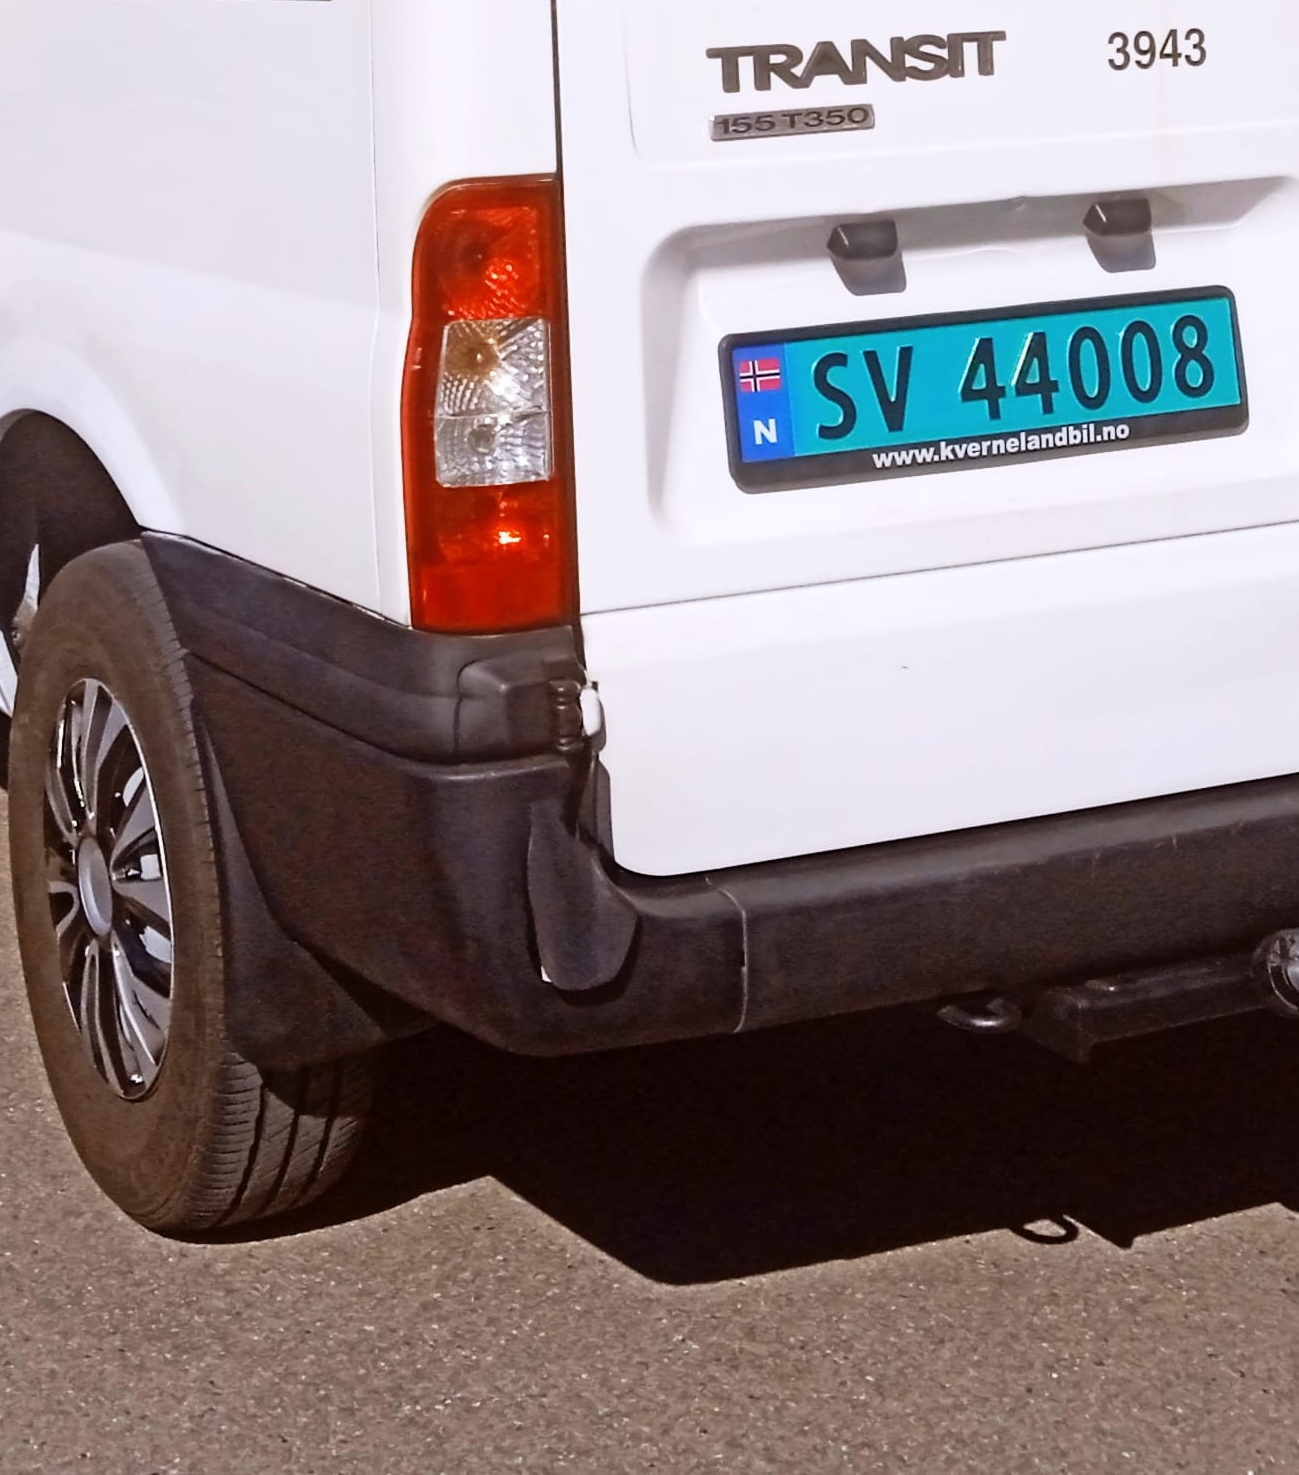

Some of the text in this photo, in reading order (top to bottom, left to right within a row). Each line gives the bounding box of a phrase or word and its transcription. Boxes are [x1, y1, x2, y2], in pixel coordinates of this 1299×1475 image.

[705, 30, 1008, 94] TRANSIT
[1106, 27, 1209, 72] 3943
[716, 107, 870, 135] 155 T350
[812, 313, 1216, 441] SV 44008
[753, 418, 779, 446] N
[871, 422, 1132, 470] www.kvernelandbil.no
